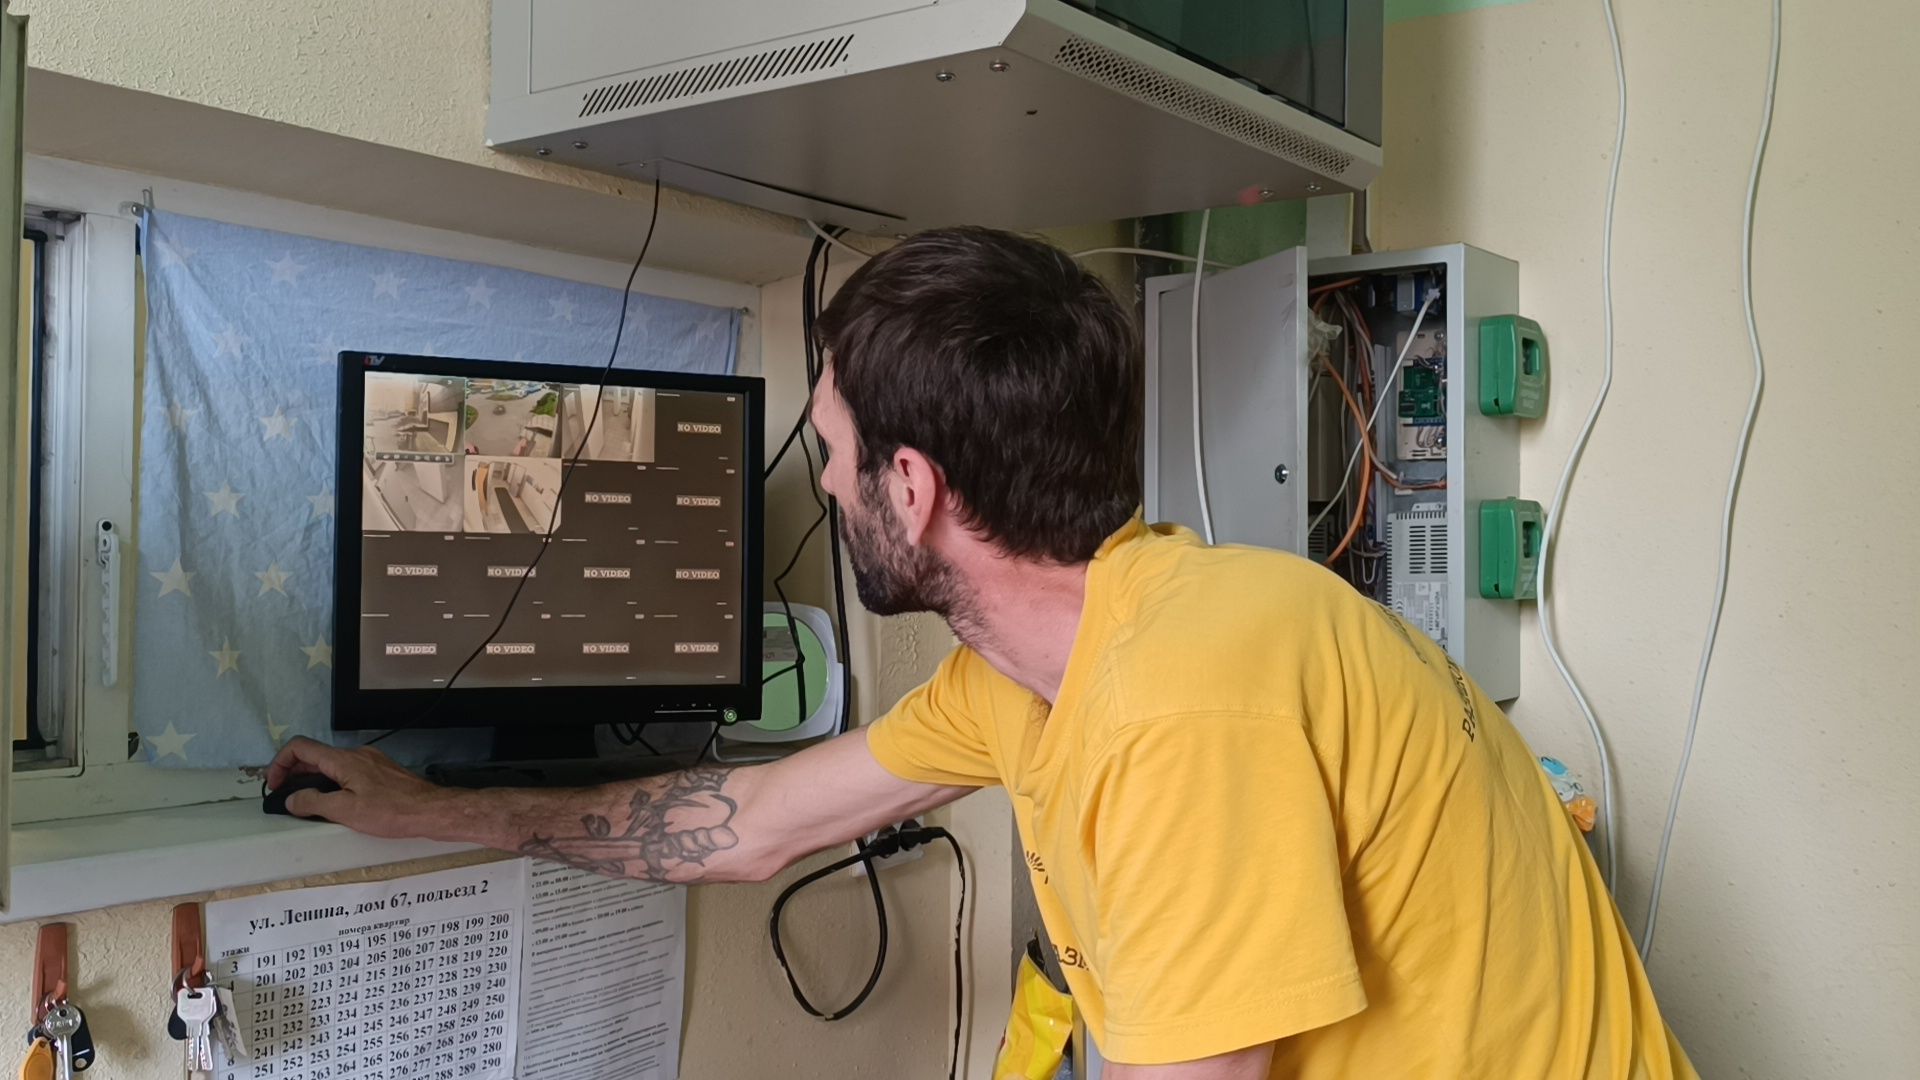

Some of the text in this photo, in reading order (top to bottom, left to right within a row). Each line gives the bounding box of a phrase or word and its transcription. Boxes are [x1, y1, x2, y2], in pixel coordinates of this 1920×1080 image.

[677, 423, 721, 433] NO VIDEO
[585, 493, 632, 504] NO VIDEO
[676, 496, 721, 507] NO VIDEO
[387, 566, 438, 576] NO VIDEO
[487, 567, 502, 577] NO
[584, 569, 631, 578] NO VIDEO
[676, 570, 720, 579] NO VIDEO
[386, 644, 437, 654] NO VIDEO
[486, 644, 536, 654] NO VIDEO
[583, 644, 630, 653] NO VIDEO
[674, 644, 720, 653] NO VIDEO
[249, 880, 489, 935] ул. Ленина, дом 67, подъезд 2
[338, 918, 411, 936] номера квартир
[231, 914, 509, 974] 3 191 192 193 194 195 196 197 198 199 200
[222, 946, 250, 957] этажи
[256, 973, 275, 987] 201
[286, 967, 305, 980] 202
[313, 962, 333, 976] 203
[341, 956, 359, 969] 204
[367, 951, 386, 965] 205
[392, 946, 411, 960] 206
[416, 942, 434, 954] 207
[440, 937, 458, 950] 208
[464, 933, 482, 946] 209
[489, 929, 508, 942] 210
[255, 946, 507, 1005] 211 212 213 214 215 216 217 218 219 220
[255, 962, 506, 1023] 221 222 223 224 225 226 227 228 229 230
[254, 978, 506, 1042] 231 232 233 234 235 236 237 238 239 240
[255, 1044, 273, 1060] 241
[283, 1038, 302, 1051] 242
[310, 1032, 330, 1045] 243
[338, 1025, 356, 1038] 244
[364, 1019, 383, 1032] 245
[390, 1014, 409, 1027] 246
[414, 1008, 432, 1022] 247
[438, 1004, 456, 1017] 248
[462, 998, 479, 1012] 249
[486, 994, 504, 1007] 250
[255, 1063, 273, 1078] 251
[284, 1056, 303, 1069] 252
[311, 1049, 330, 1062] 253
[337, 1042, 356, 1057] 254
[364, 1036, 382, 1049] 255
[390, 1032, 409, 1045] 256
[414, 1025, 432, 1038] 257
[438, 1020, 455, 1034] 258
[460, 1014, 478, 1027] 259
[484, 1010, 504, 1023] 260
[311, 1067, 330, 1080] 263
[338, 1060, 356, 1073] 264
[364, 1054, 382, 1067] 265
[390, 1048, 409, 1062] 266
[414, 1042, 432, 1056] 267
[436, 1036, 454, 1050] 268
[459, 1030, 477, 1044] 269
[484, 1026, 502, 1039] 270
[390, 1065, 408, 1079] 276
[414, 1058, 430, 1071] 277
[435, 1052, 453, 1066] 278
[459, 1046, 476, 1060] 279
[483, 1042, 501, 1055] 280
[459, 1062, 476, 1076] 289
[482, 1057, 500, 1070] 290
